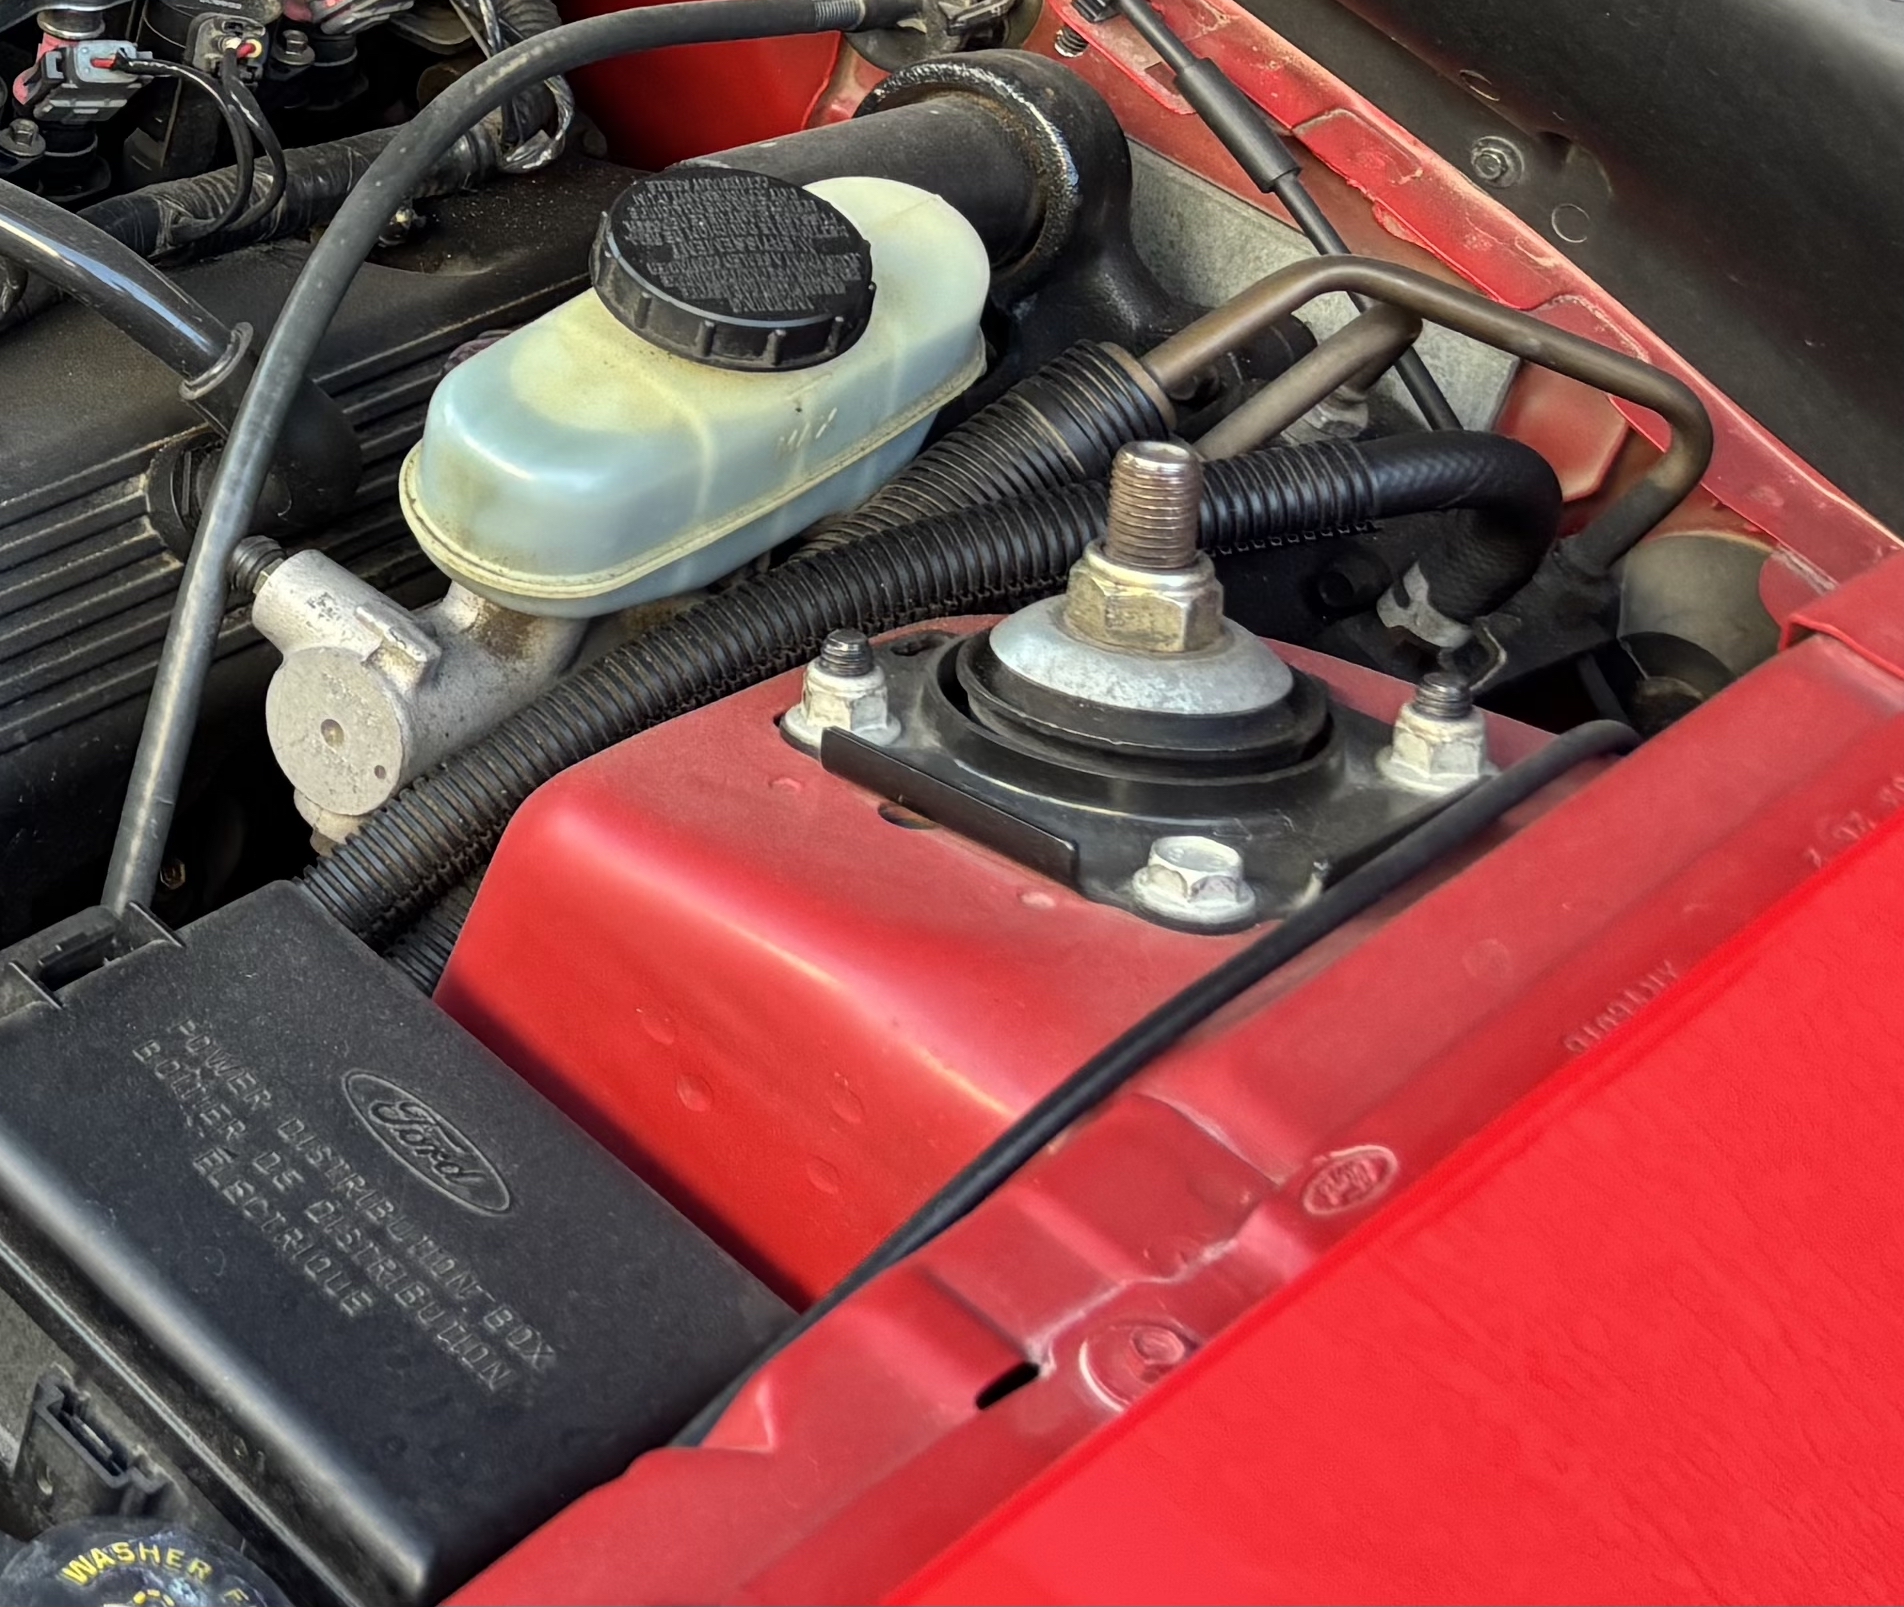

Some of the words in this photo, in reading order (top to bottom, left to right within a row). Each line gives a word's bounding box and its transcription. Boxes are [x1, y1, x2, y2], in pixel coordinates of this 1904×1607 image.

[177, 1018, 272, 1112] POWER
[276, 1116, 488, 1300] DISTRIBUTION
[484, 1303, 556, 1372] BOX
[368, 1099, 487, 1187] Ford
[253, 1149, 306, 1194] DE
[304, 1198, 517, 1393] DISTRIBUTION
[59, 1541, 214, 1587] WASHER
